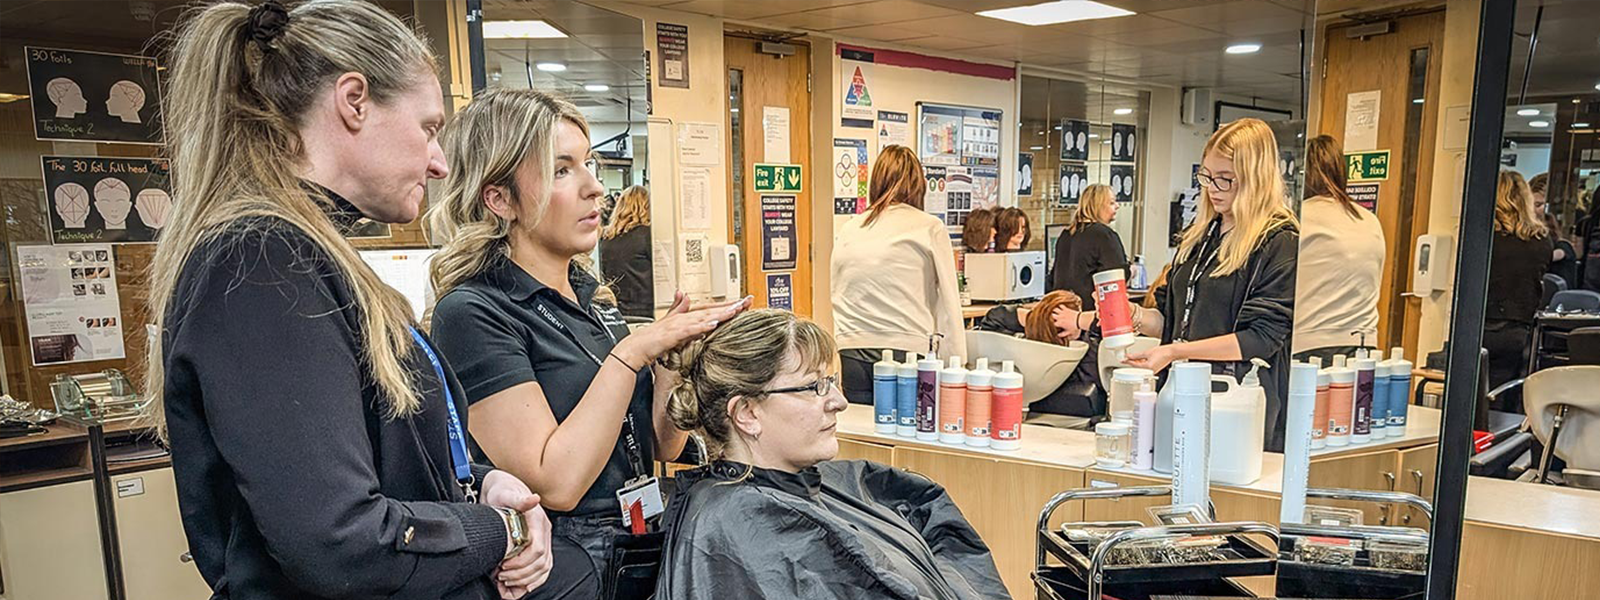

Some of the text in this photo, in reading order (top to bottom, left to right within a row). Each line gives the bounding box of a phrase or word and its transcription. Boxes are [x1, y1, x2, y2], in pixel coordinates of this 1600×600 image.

[32, 50, 48, 61] 30
[40, 119, 95, 137] Technique 2
[46, 159, 66, 171] The
[72, 160, 87, 172] 30
[109, 162, 125, 174] full
[127, 163, 148, 174] head
[757, 168, 768, 177] Fire
[54, 230, 103, 242] Technique 2
[537, 304, 564, 330] STUDENT
